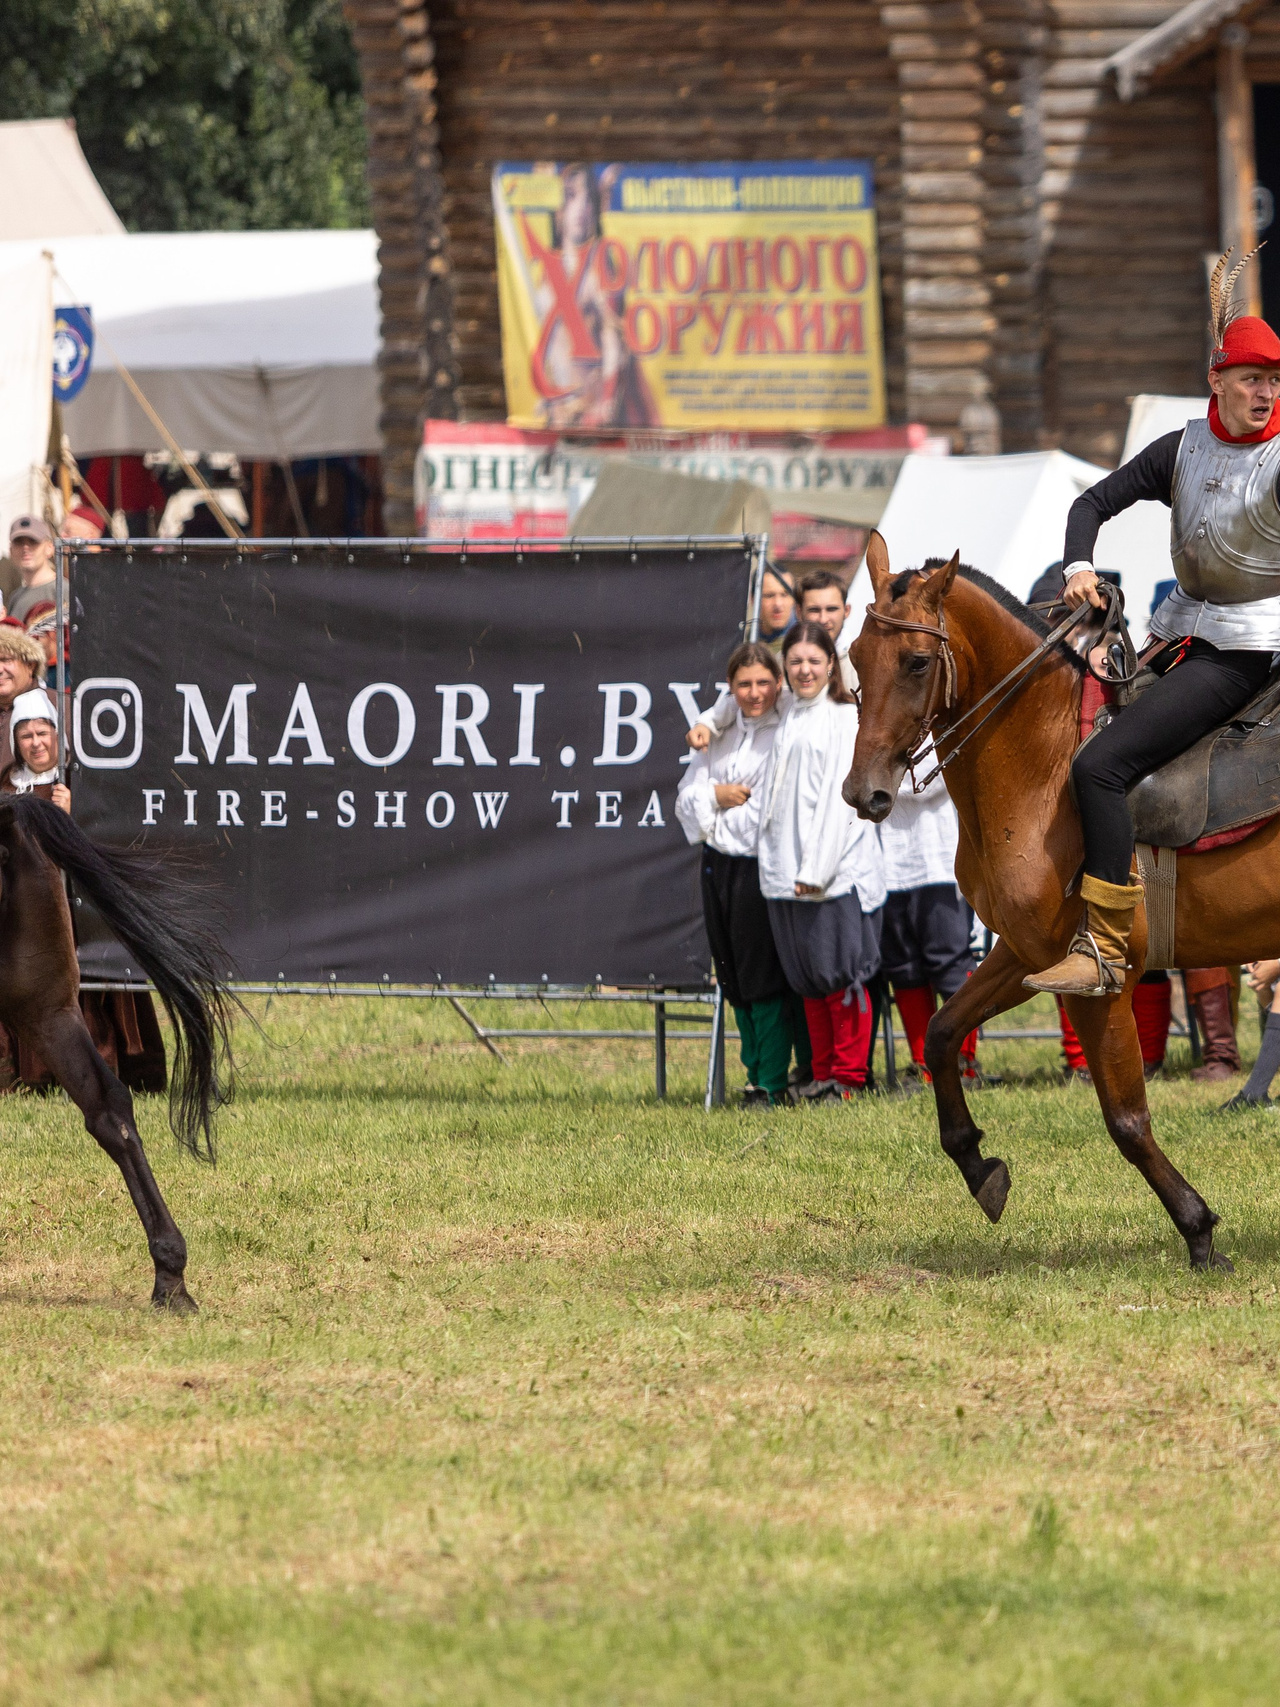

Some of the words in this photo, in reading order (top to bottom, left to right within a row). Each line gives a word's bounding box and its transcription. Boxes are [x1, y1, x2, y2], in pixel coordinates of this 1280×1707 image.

[623, 300, 867, 356] ОРУЖИЯ
[783, 455, 900, 490] ОРУЖ
[173, 681, 730, 767] MAORI.BY
[142, 788, 510, 829] FIRE-SHOW
[552, 789, 667, 828] TEA
